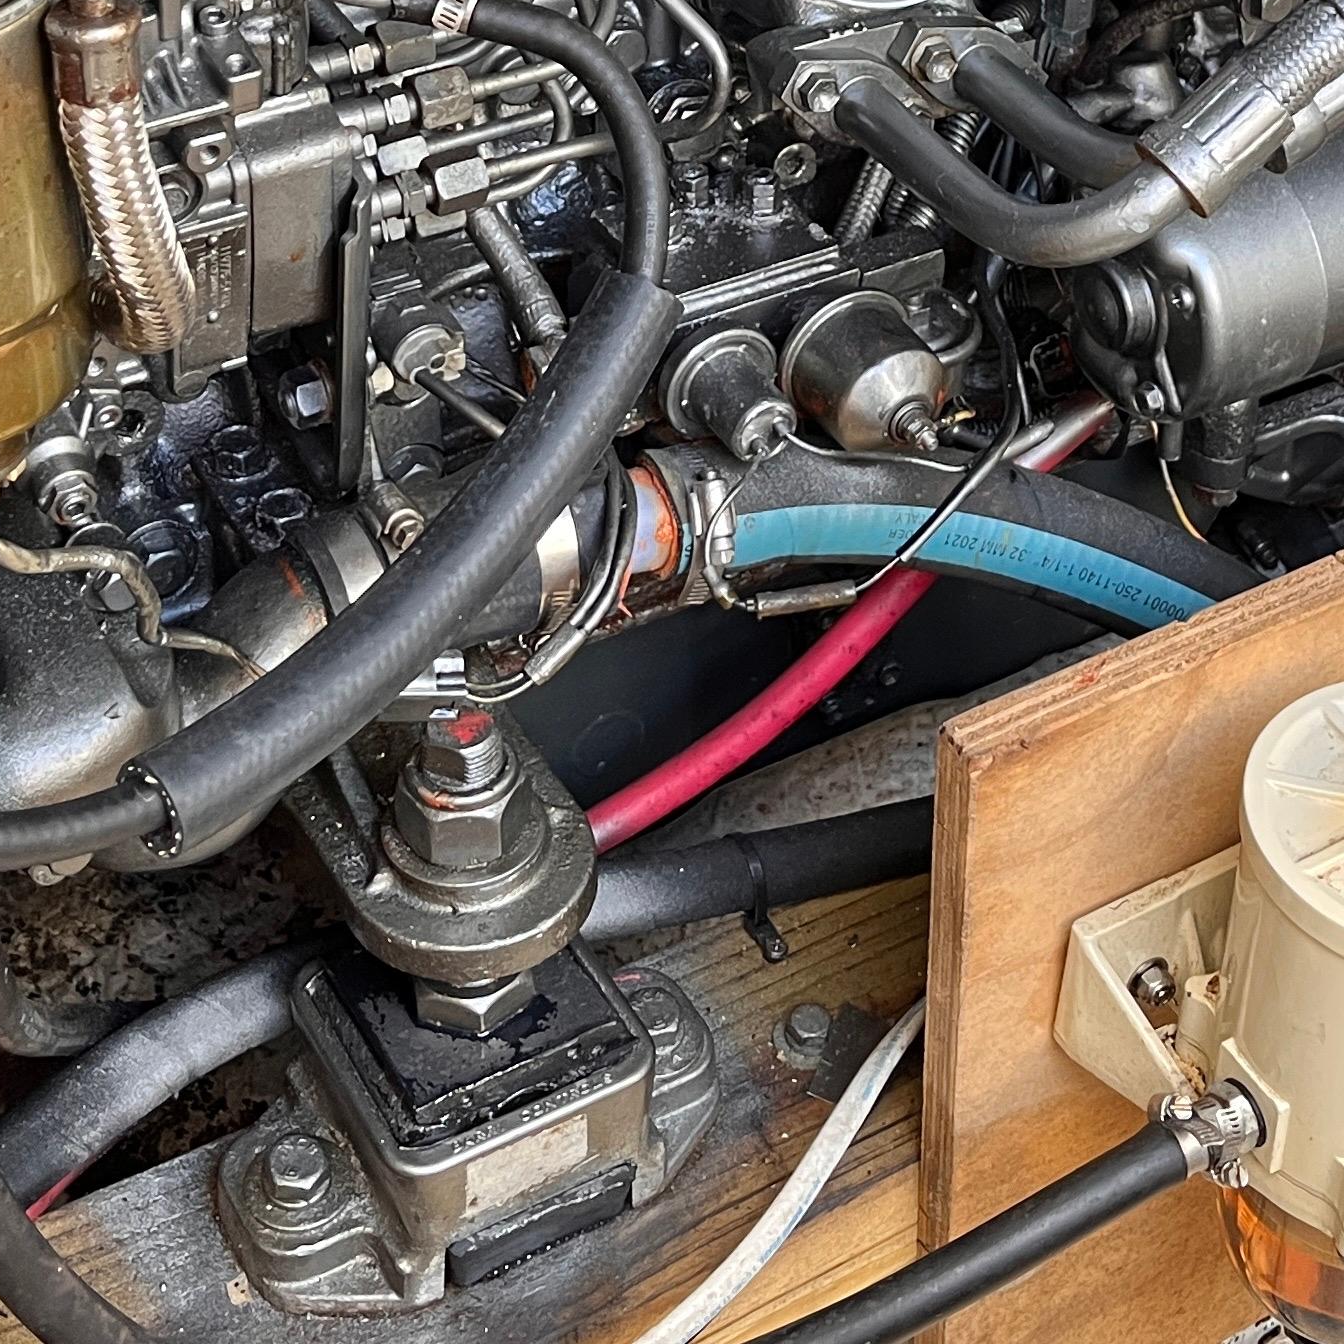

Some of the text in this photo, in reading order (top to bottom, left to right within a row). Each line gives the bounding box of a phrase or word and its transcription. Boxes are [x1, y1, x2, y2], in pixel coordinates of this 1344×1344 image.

[887, 528, 913, 539] DER
[944, 532, 978, 551] 2021
[979, 539, 1009, 557] MM
[1076, 566, 1142, 603] 250-1140
